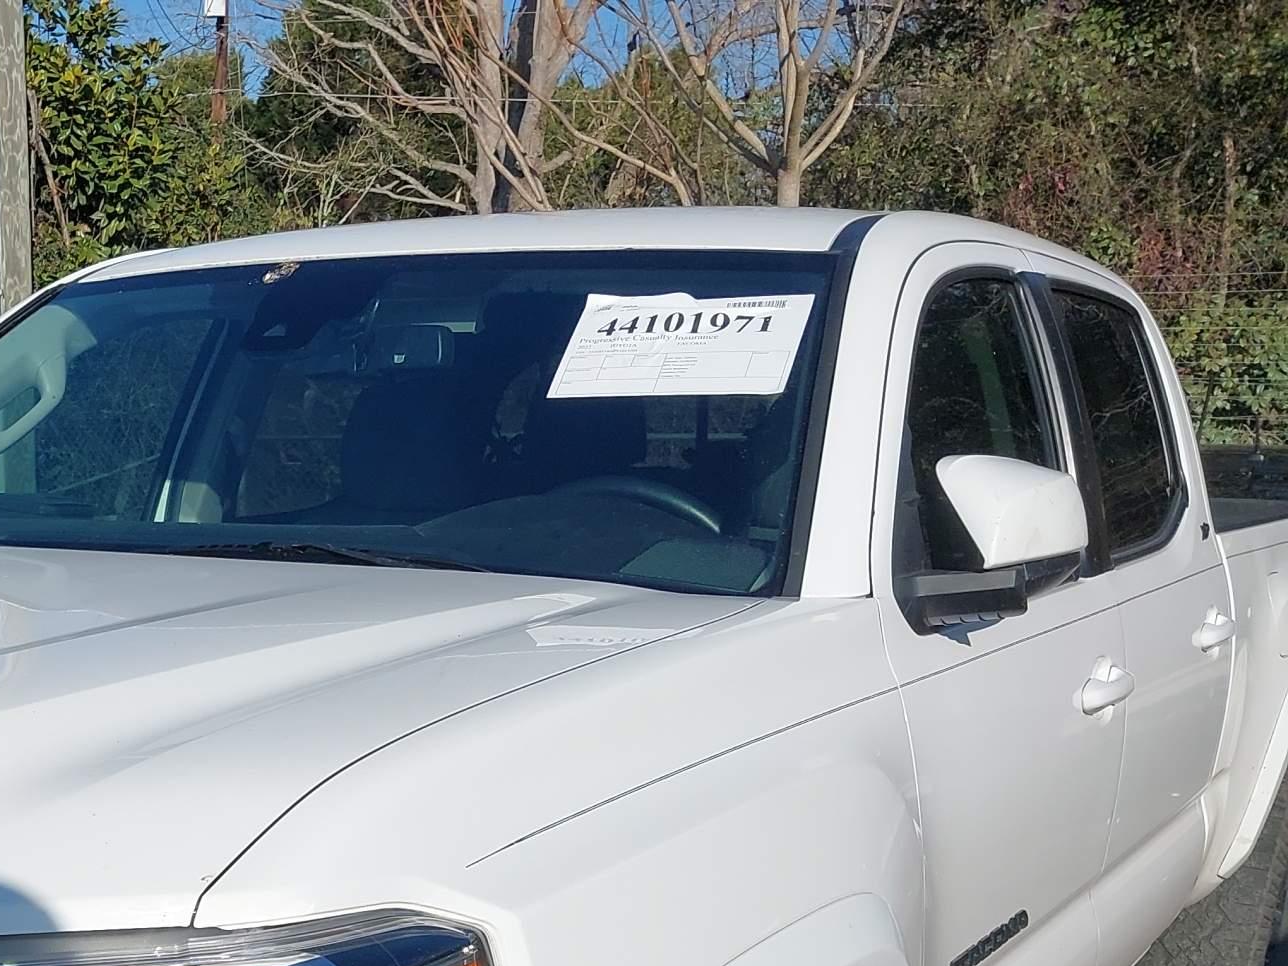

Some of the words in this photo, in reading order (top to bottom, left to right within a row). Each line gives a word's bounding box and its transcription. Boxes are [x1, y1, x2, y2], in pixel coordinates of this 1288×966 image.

[597, 312, 773, 337] 44101971
[579, 335, 630, 344] Progressive
[632, 334, 672, 343] Casualty
[673, 333, 719, 341] Insurance
